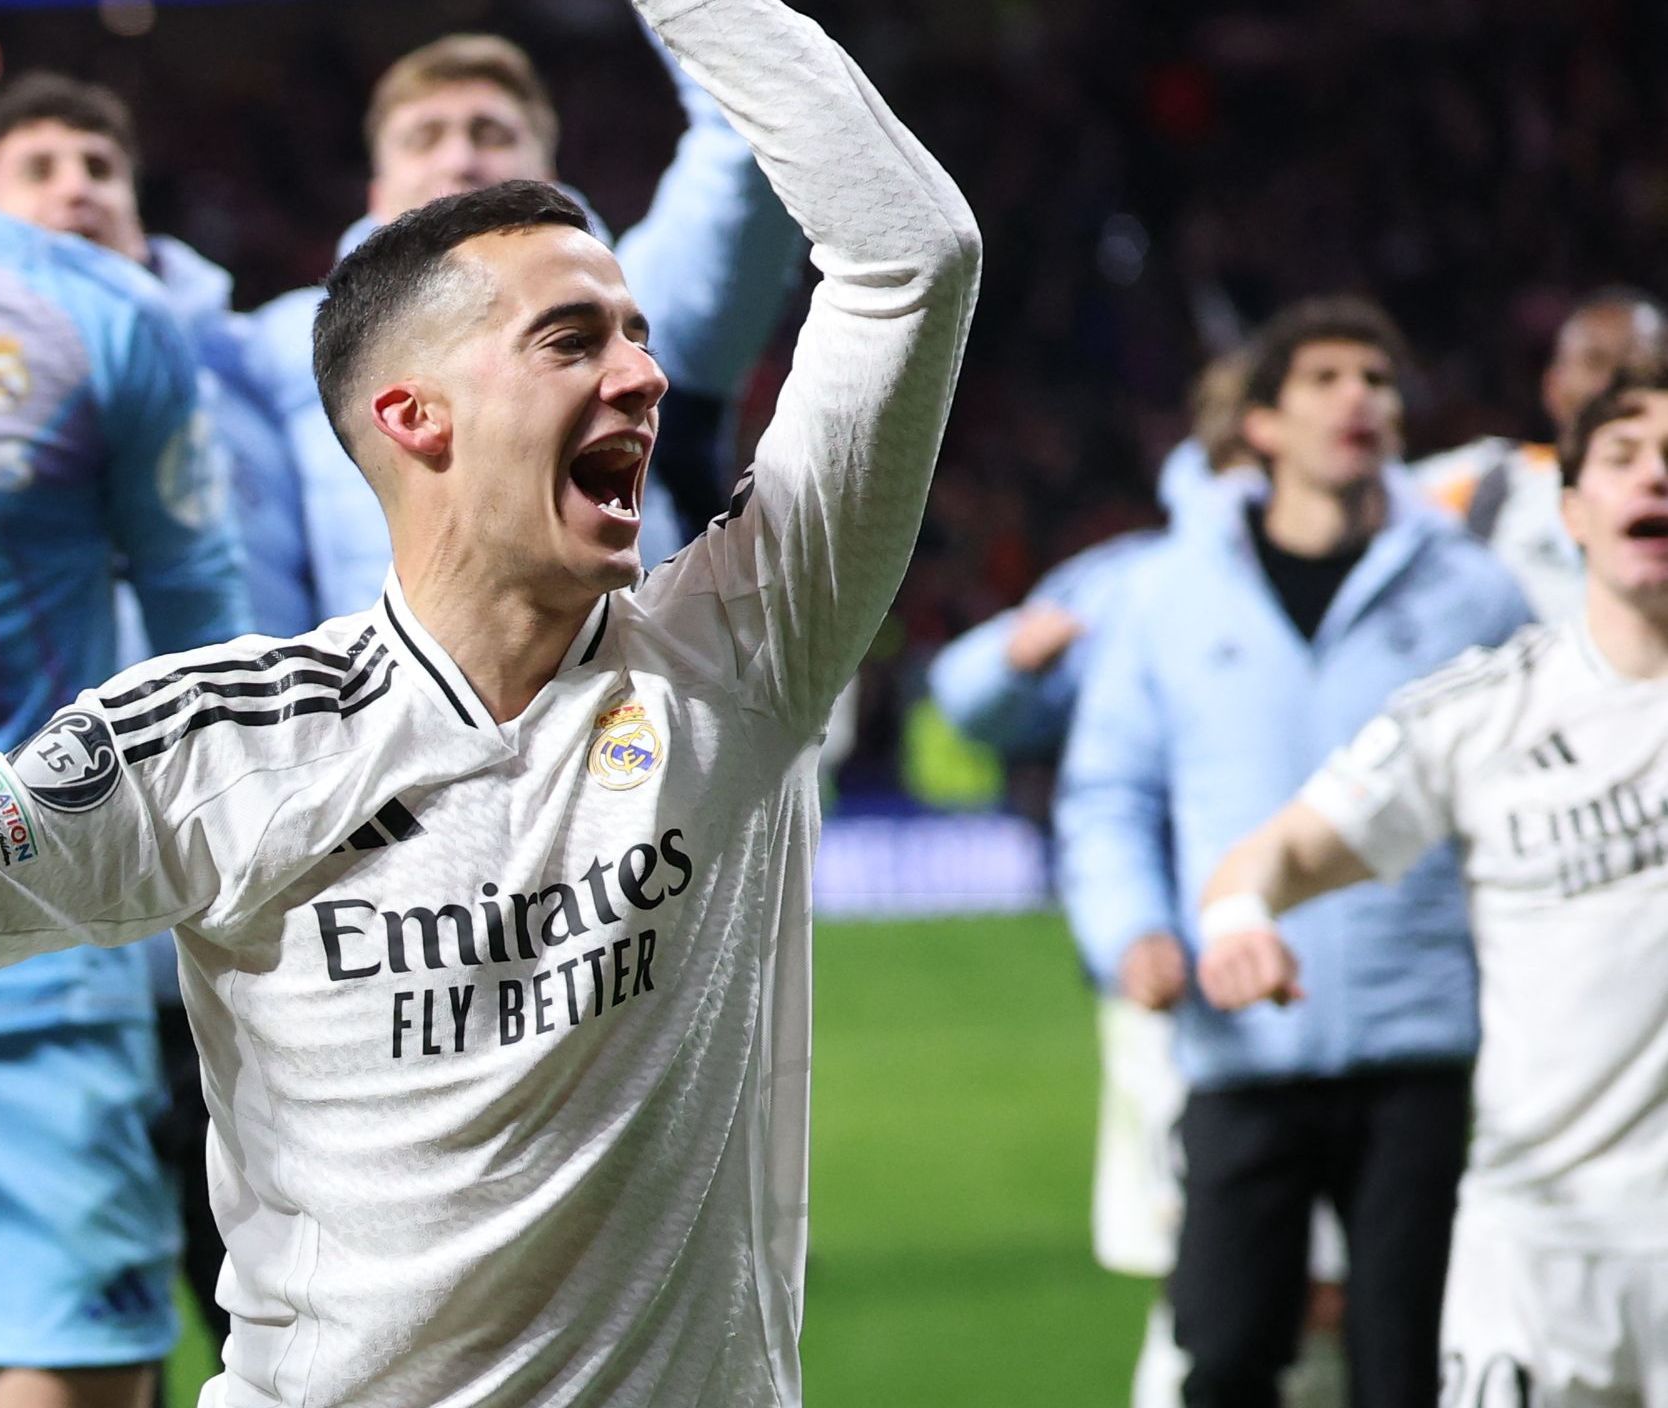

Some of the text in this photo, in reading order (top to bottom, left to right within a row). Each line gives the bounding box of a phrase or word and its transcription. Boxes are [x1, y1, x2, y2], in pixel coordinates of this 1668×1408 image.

[36, 742, 76, 773] 15
[312, 828, 693, 982] Emirates
[392, 928, 656, 1059] FLY BETTER
